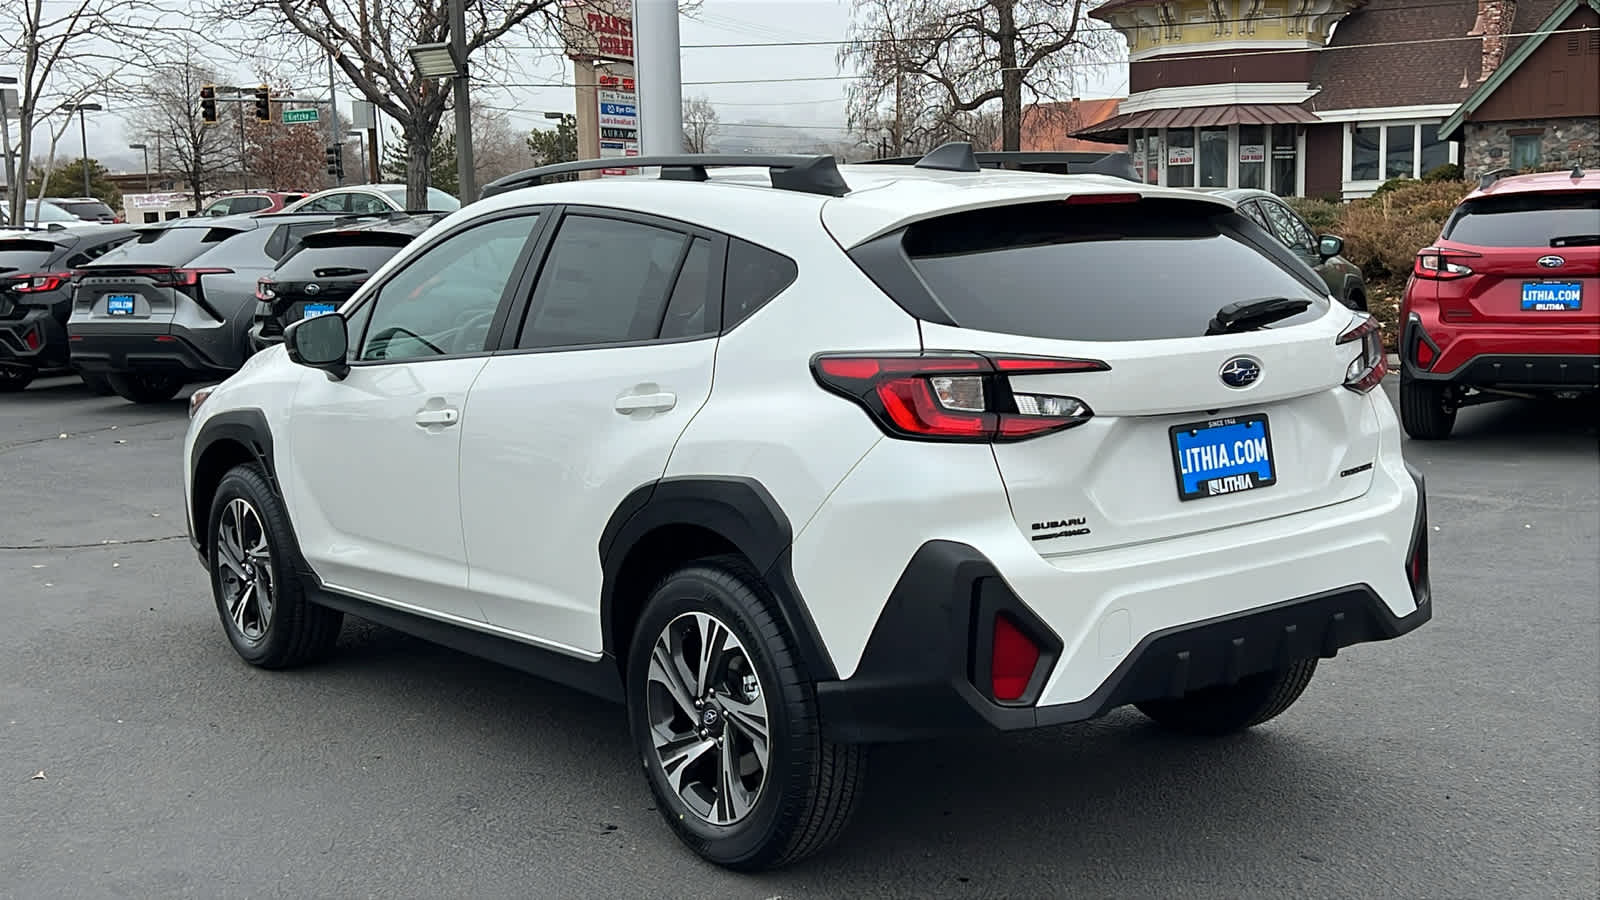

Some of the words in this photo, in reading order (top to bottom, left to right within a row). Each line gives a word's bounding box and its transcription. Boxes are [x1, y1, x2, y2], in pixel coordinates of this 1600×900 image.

[1523, 290, 1580, 301] LITHIA.COM
[1179, 437, 1269, 475] LITHIA.COM
[1219, 474, 1254, 493] LITHIA
[1032, 517, 1086, 530] SUBARU
